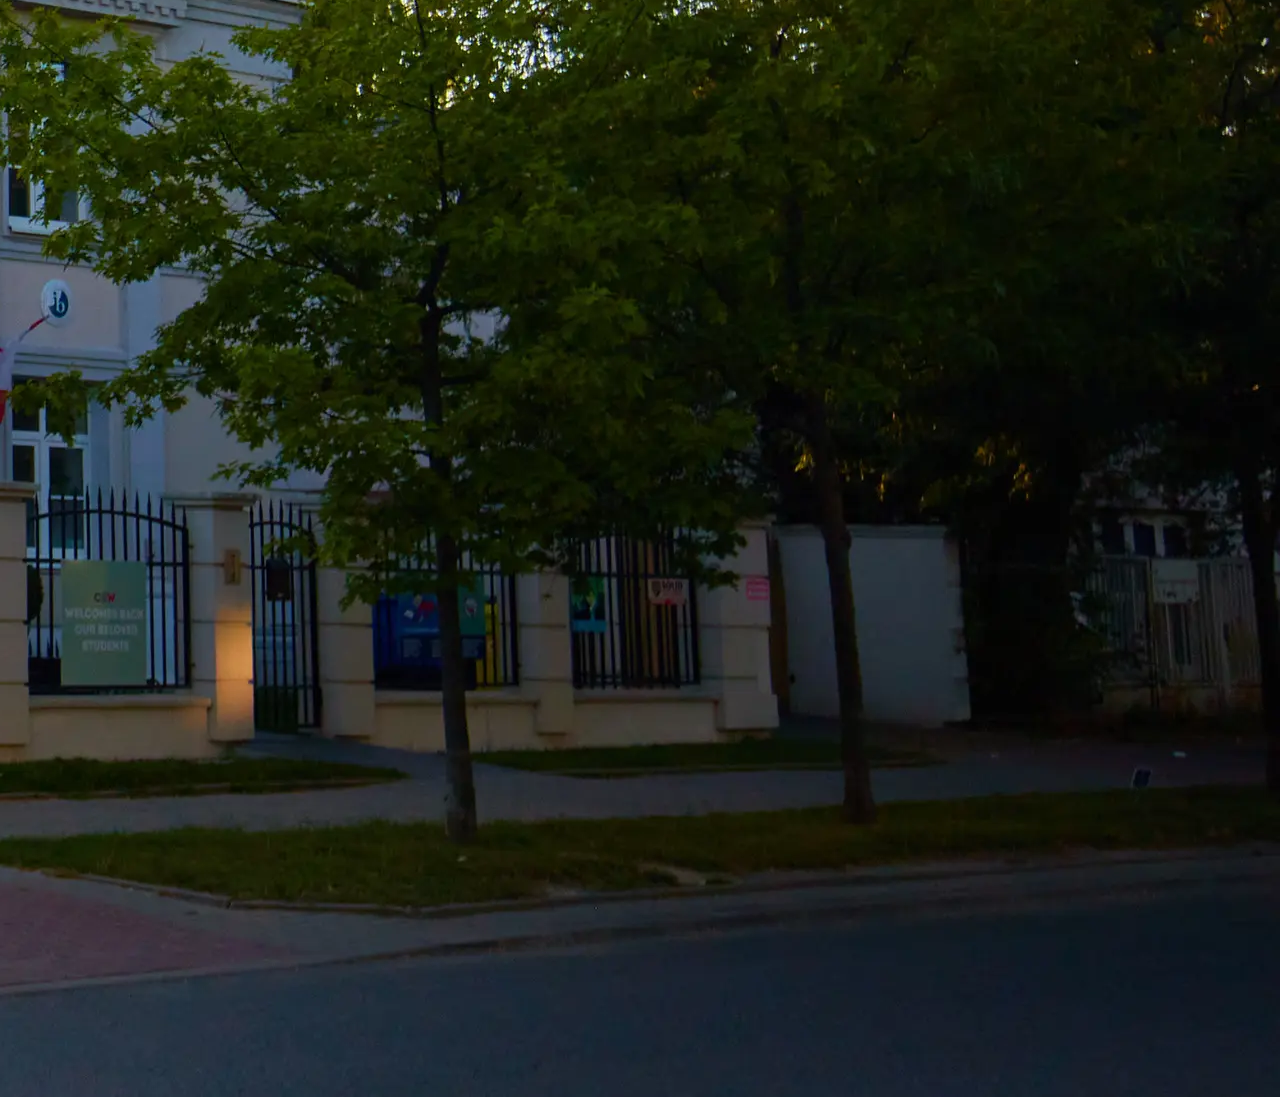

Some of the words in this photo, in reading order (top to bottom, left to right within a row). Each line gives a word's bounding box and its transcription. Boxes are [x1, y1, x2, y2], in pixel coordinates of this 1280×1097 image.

[75, 624, 96, 635] OUR
[98, 624, 139, 636] BELOVED
[82, 640, 130, 652] STUDENTS
